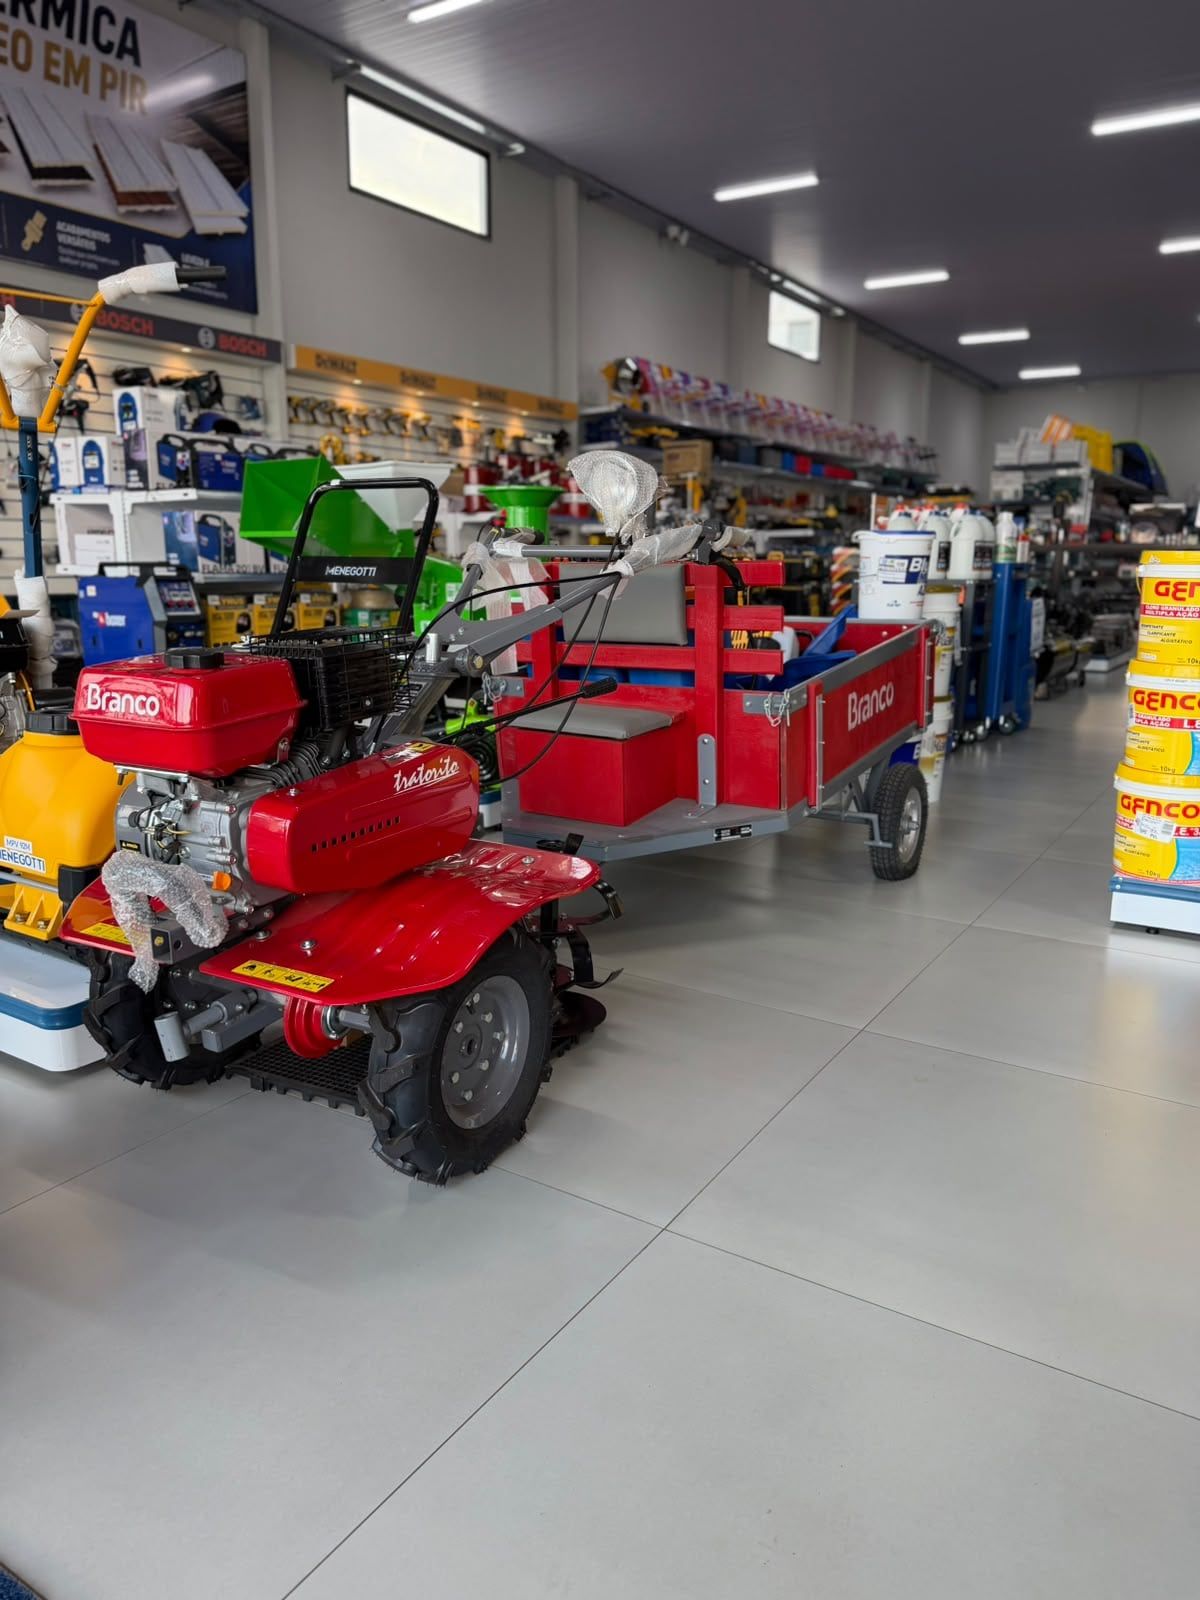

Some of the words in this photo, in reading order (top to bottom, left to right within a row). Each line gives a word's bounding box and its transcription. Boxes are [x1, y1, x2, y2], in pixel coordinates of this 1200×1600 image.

[43, 40, 91, 97] EM
[100, 62, 149, 116] PIR
[98, 311, 155, 336] BOSCH
[218, 334, 267, 357] BOSCH
[325, 565, 377, 577] MENEGOTTI
[1176, 610, 1199, 618] AÇÃO
[88, 683, 160, 718] Branco
[848, 681, 895, 732] Branco
[1133, 689, 1200, 712] GENC
[394, 755, 460, 793] tratorito
[1121, 794, 1200, 820] GENCO
[0, 848, 45, 872] ENEGOTTI
